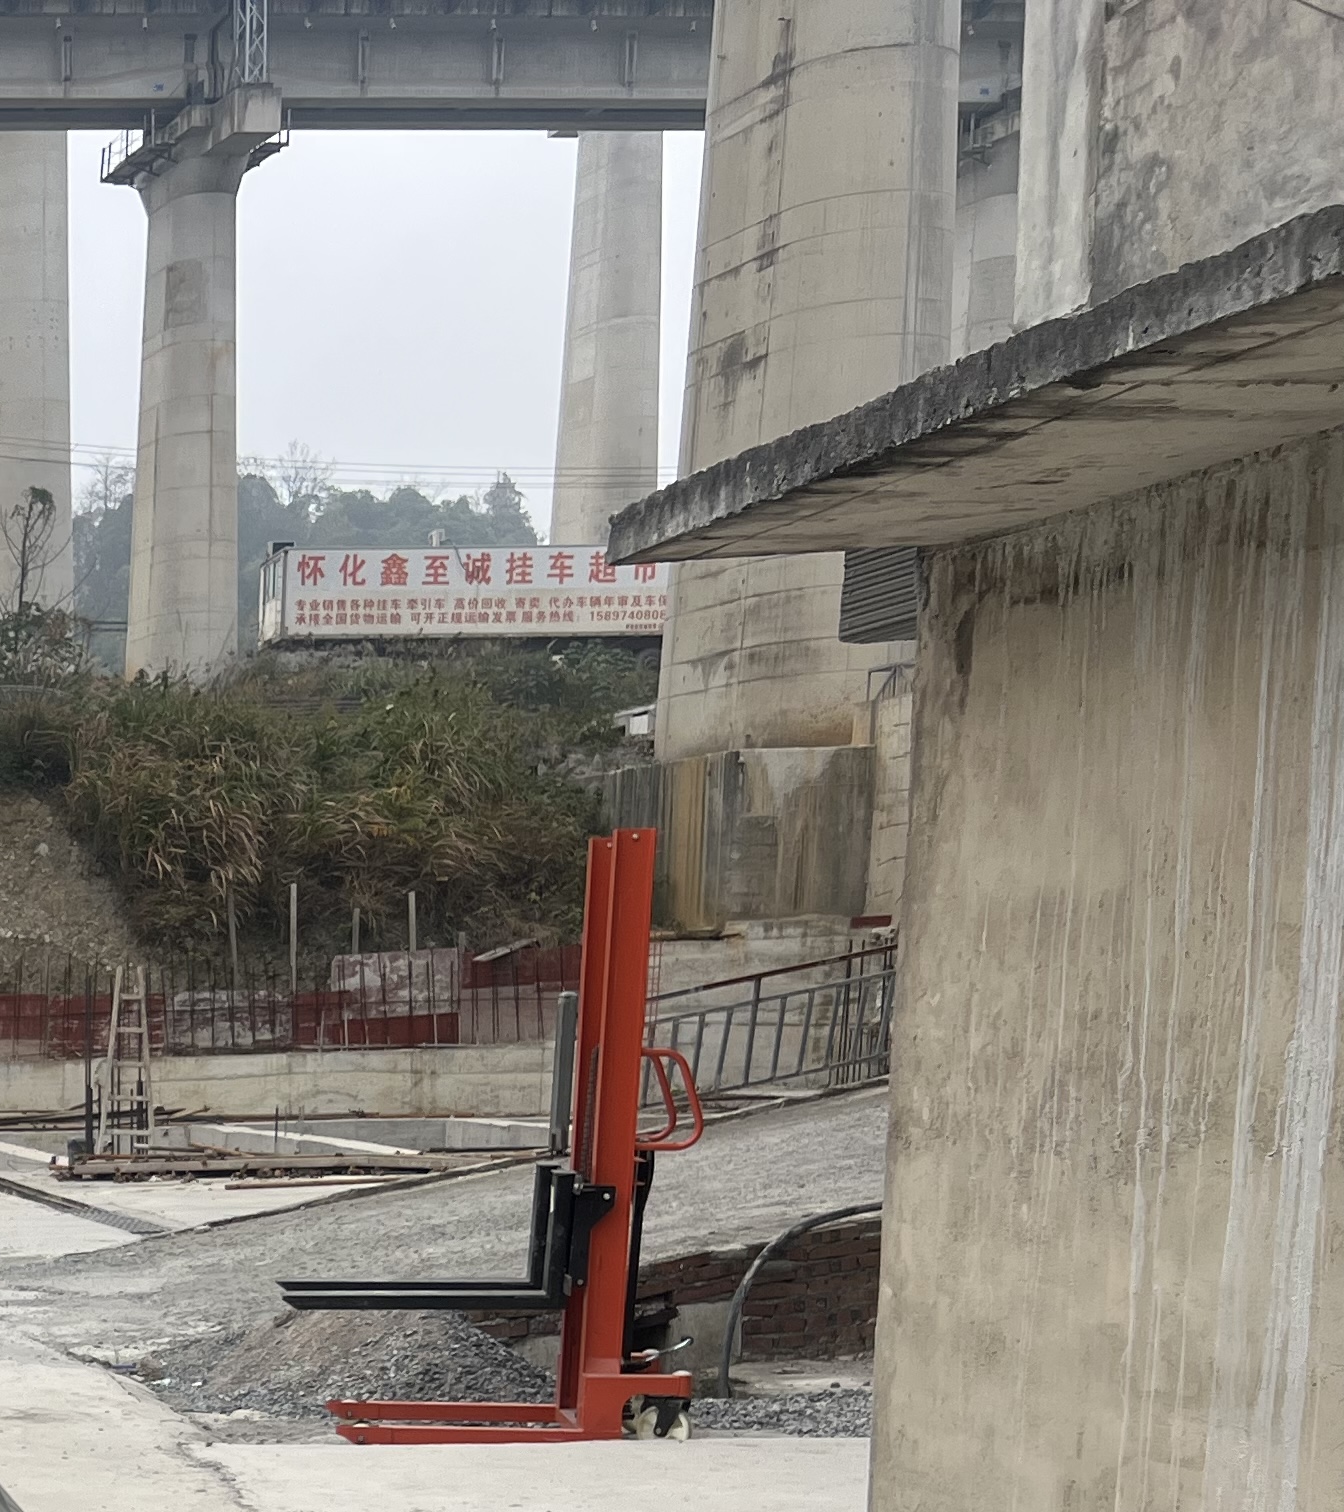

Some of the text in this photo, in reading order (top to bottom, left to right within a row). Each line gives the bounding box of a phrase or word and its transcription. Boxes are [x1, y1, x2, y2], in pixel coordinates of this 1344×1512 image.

[297, 551, 657, 586] 怀化鑫至诚挂车超市
